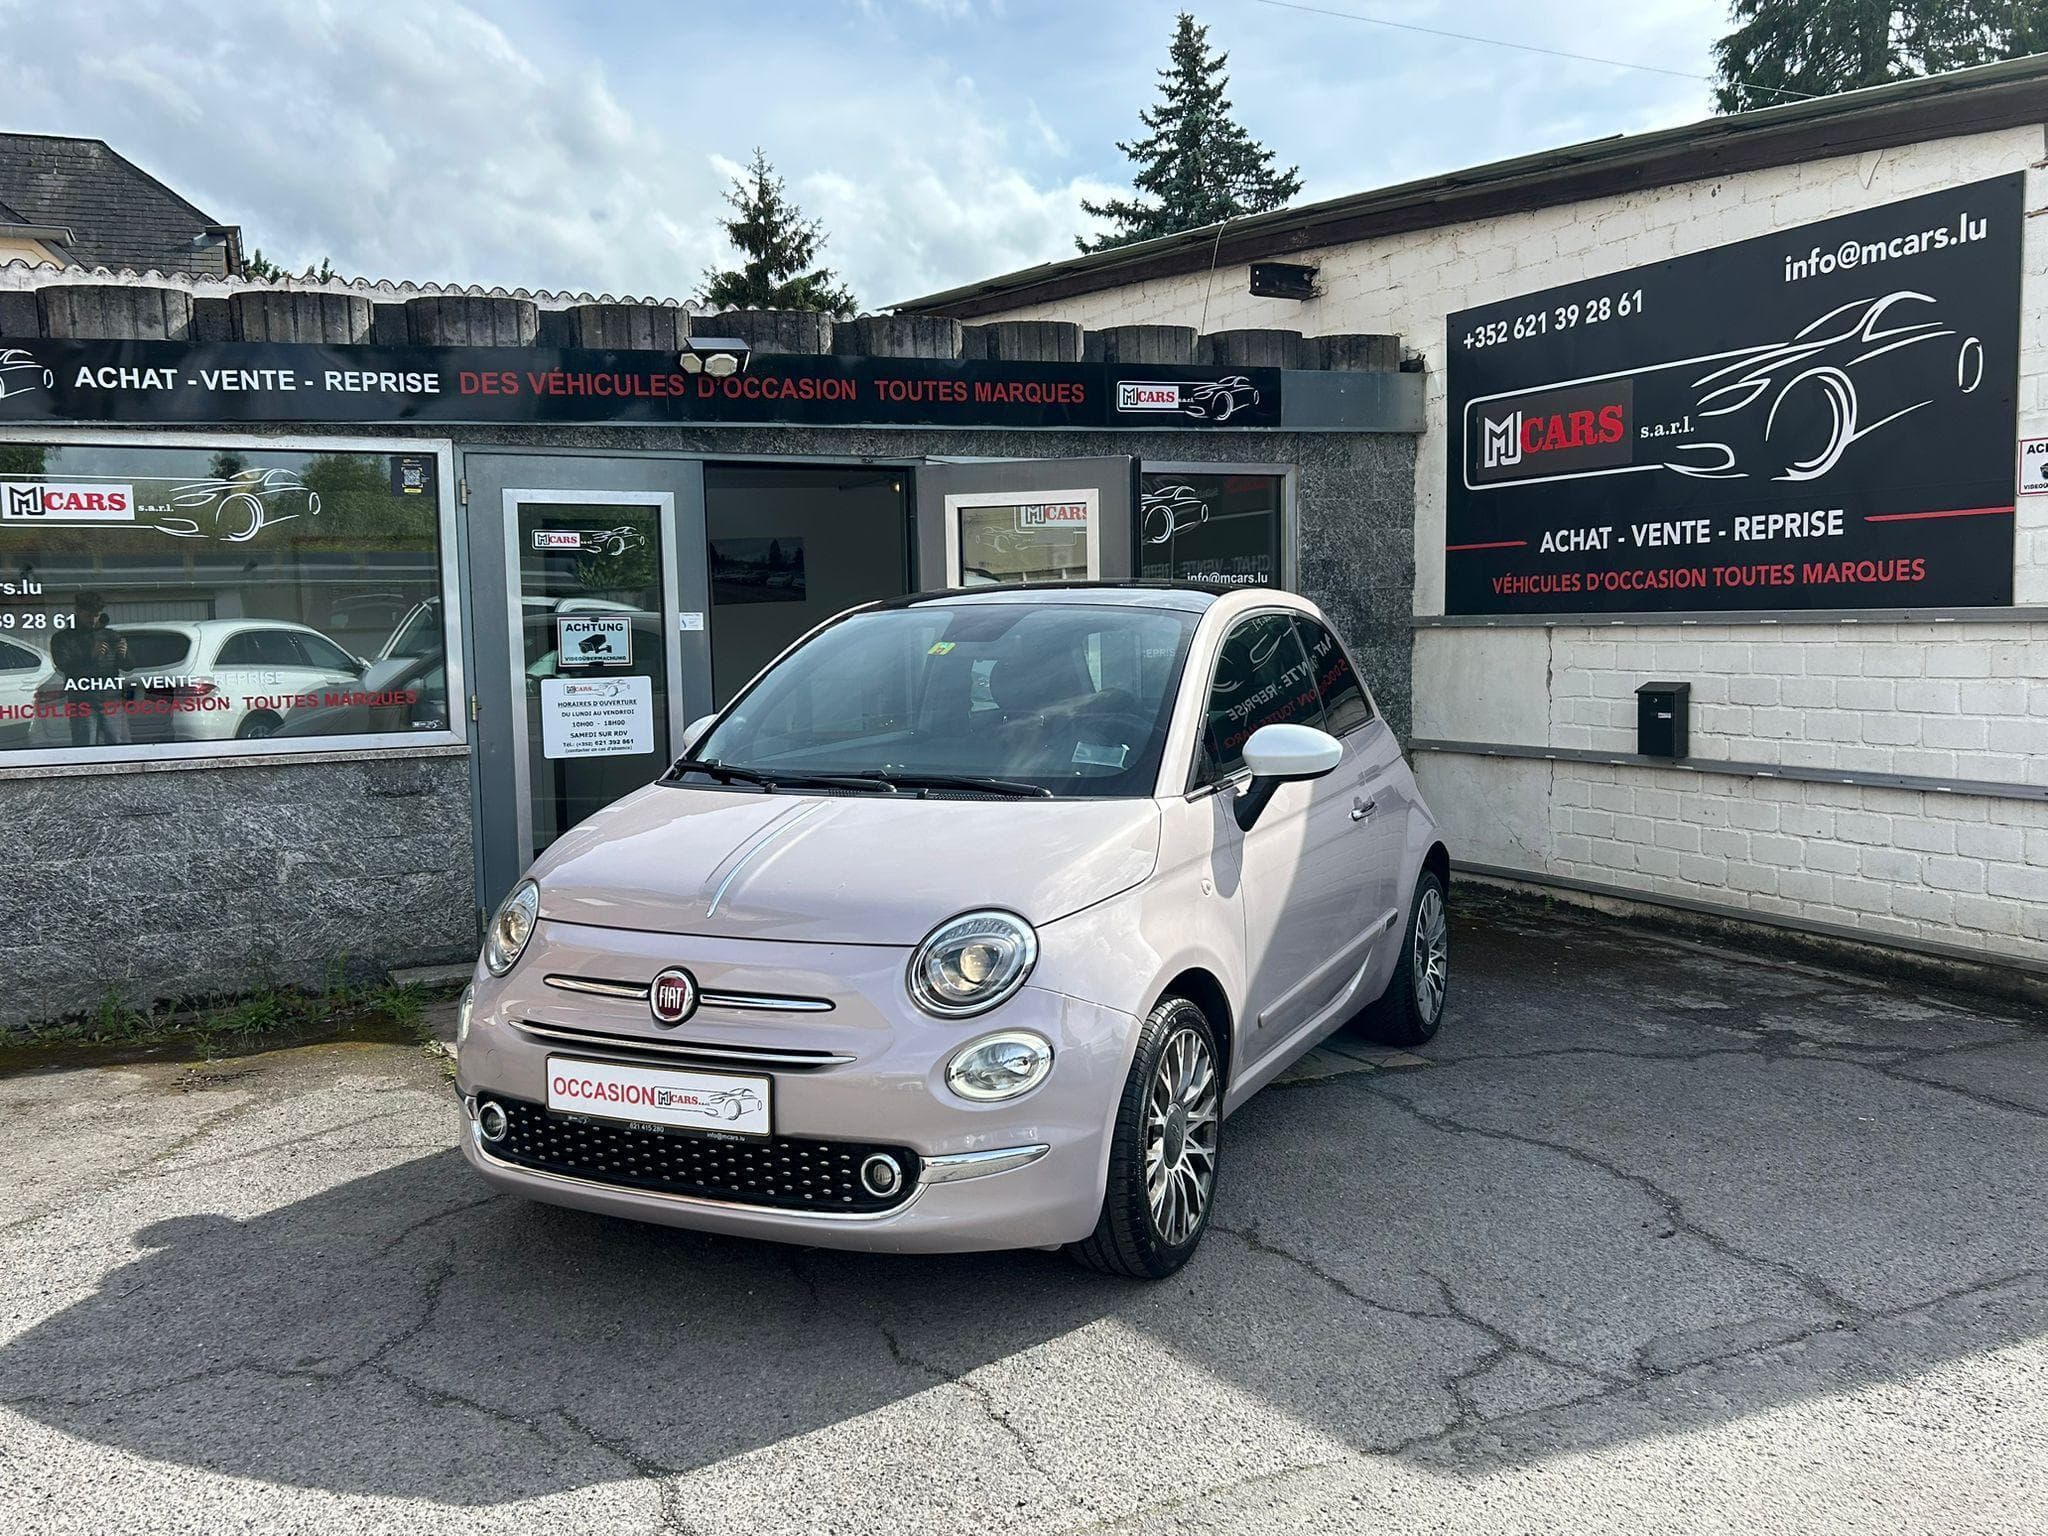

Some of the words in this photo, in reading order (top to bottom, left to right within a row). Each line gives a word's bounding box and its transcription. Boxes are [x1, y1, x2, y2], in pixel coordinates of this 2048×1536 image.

[1785, 212, 1988, 282] info@mcars.lu
[1463, 321, 1508, 350] +352
[1513, 311, 1547, 340] 621
[1554, 304, 1580, 331] 39
[1585, 296, 1611, 324] 28
[1617, 289, 1643, 317] 61
[74, 366, 178, 390] ACHAT
[324, 370, 441, 394] REPRISE
[459, 371, 519, 394] DES
[527, 366, 686, 397] VÉHICULES
[697, 375, 857, 401] D'OCCASION
[874, 380, 969, 402] TOUTES
[974, 382, 1086, 404] MARQUES
[1640, 415, 1695, 439] s.a.r.l.
[1539, 526, 1613, 553] ACHAT
[1631, 519, 1711, 547] VENTE
[1734, 509, 1844, 541] REPRISE
[1187, 571, 1268, 584] info@mcars.lu
[1492, 572, 1581, 594] VÉHICULES
[1586, 567, 1706, 592] D'OCCASION
[1712, 564, 1795, 587] TOUTES
[1802, 558, 1926, 585] MARQUES
[0, 613, 15, 629] 9
[21, 613, 47, 629] 28
[53, 613, 76, 629] 61
[565, 623, 624, 632] ACHTUNG
[64, 676, 126, 691] ACHAT
[141, 675, 201, 689] VENTE
[102, 697, 230, 717] D'OCCASION
[242, 693, 319, 711] TOUTES
[323, 690, 417, 708] MARQUES
[557, 701, 592, 709] HORAIRES
[593, 709, 602, 717] AU
[603, 708, 635, 716] VENDREDI
[570, 731, 597, 739] SAMEDI
[598, 730, 613, 738] SUR
[604, 719, 626, 727] 18H00
[659, 985, 684, 1009] FIAT
[553, 1076, 655, 1106] OCCASION
